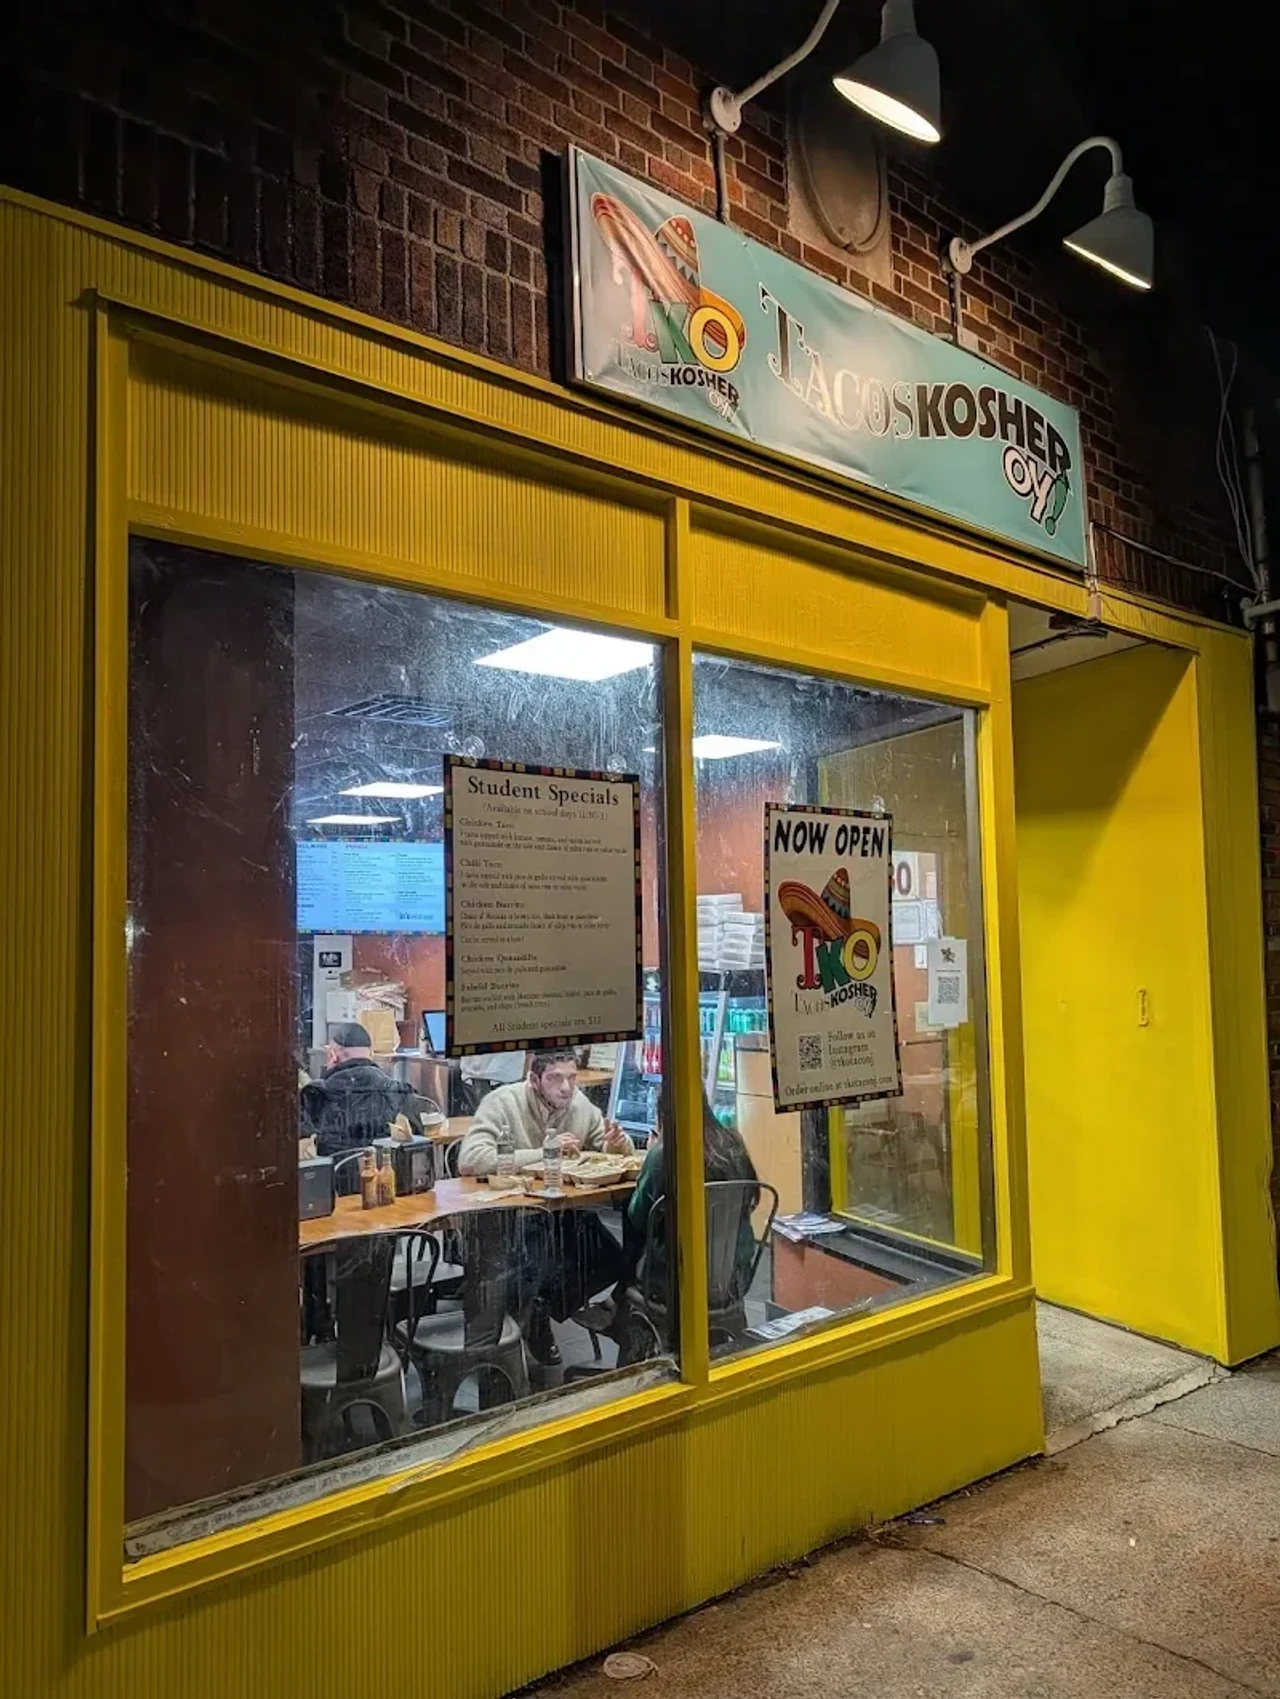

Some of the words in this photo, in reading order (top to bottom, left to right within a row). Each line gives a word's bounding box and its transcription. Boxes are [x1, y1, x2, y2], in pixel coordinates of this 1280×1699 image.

[468, 776, 541, 799] Student
[548, 784, 619, 807] Specials
[460, 818, 493, 827] Chicken
[774, 819, 829, 855] NOW
[835, 824, 885, 858] OPEN
[460, 900, 494, 908] Chicken
[791, 925, 878, 994] TKO
[491, 1022, 506, 1032] All
[507, 1020, 539, 1032] Student
[828, 1030, 854, 1042] Follow
[828, 1044, 869, 1055] Instagram
[784, 1084, 808, 1096] Order
[809, 1080, 834, 1094] online
